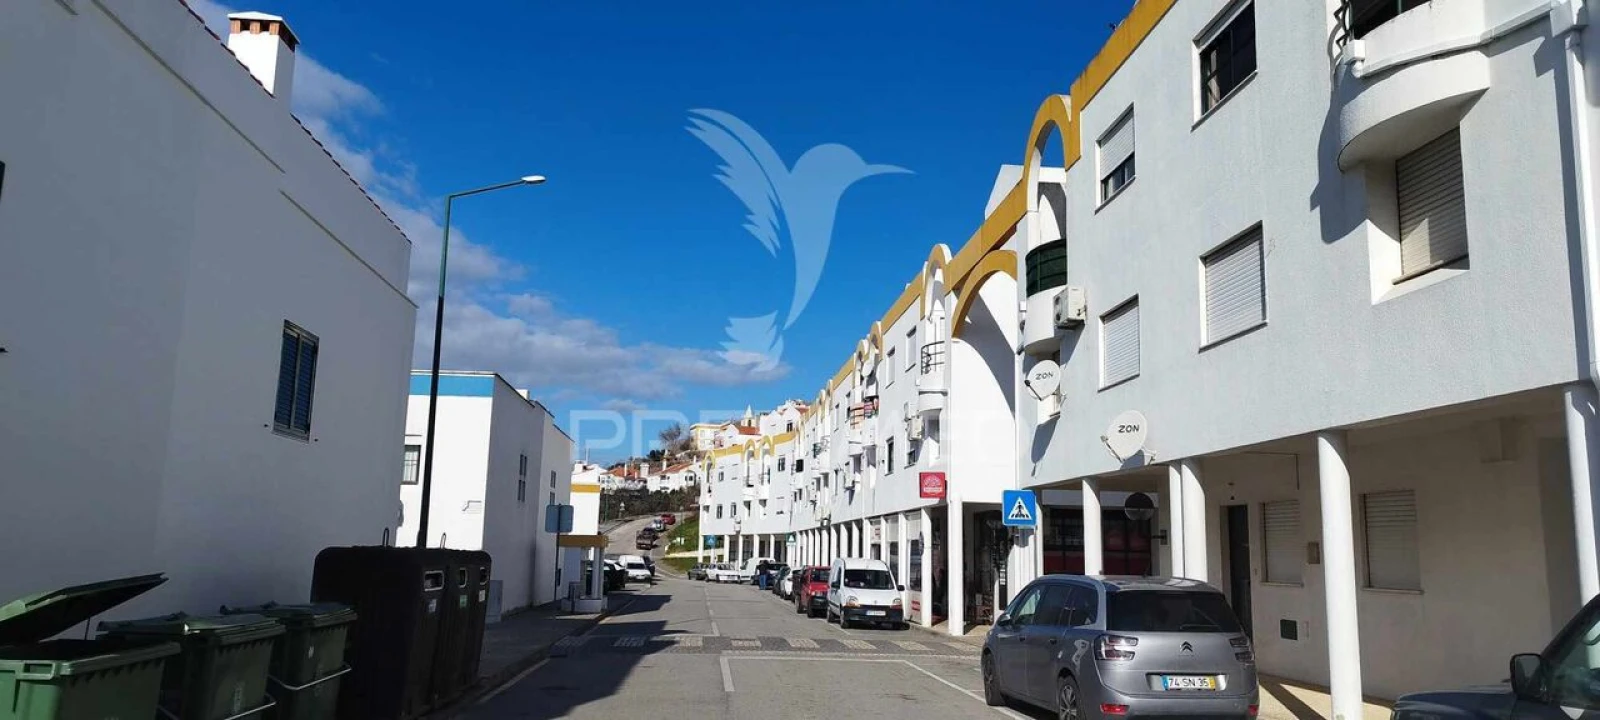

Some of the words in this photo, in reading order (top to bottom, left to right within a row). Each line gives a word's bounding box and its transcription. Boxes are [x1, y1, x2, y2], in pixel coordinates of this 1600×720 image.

[1035, 371, 1054, 380] ZON
[1117, 424, 1140, 433] ZON
[1168, 678, 1180, 687] 74
[1182, 678, 1196, 687] SN
